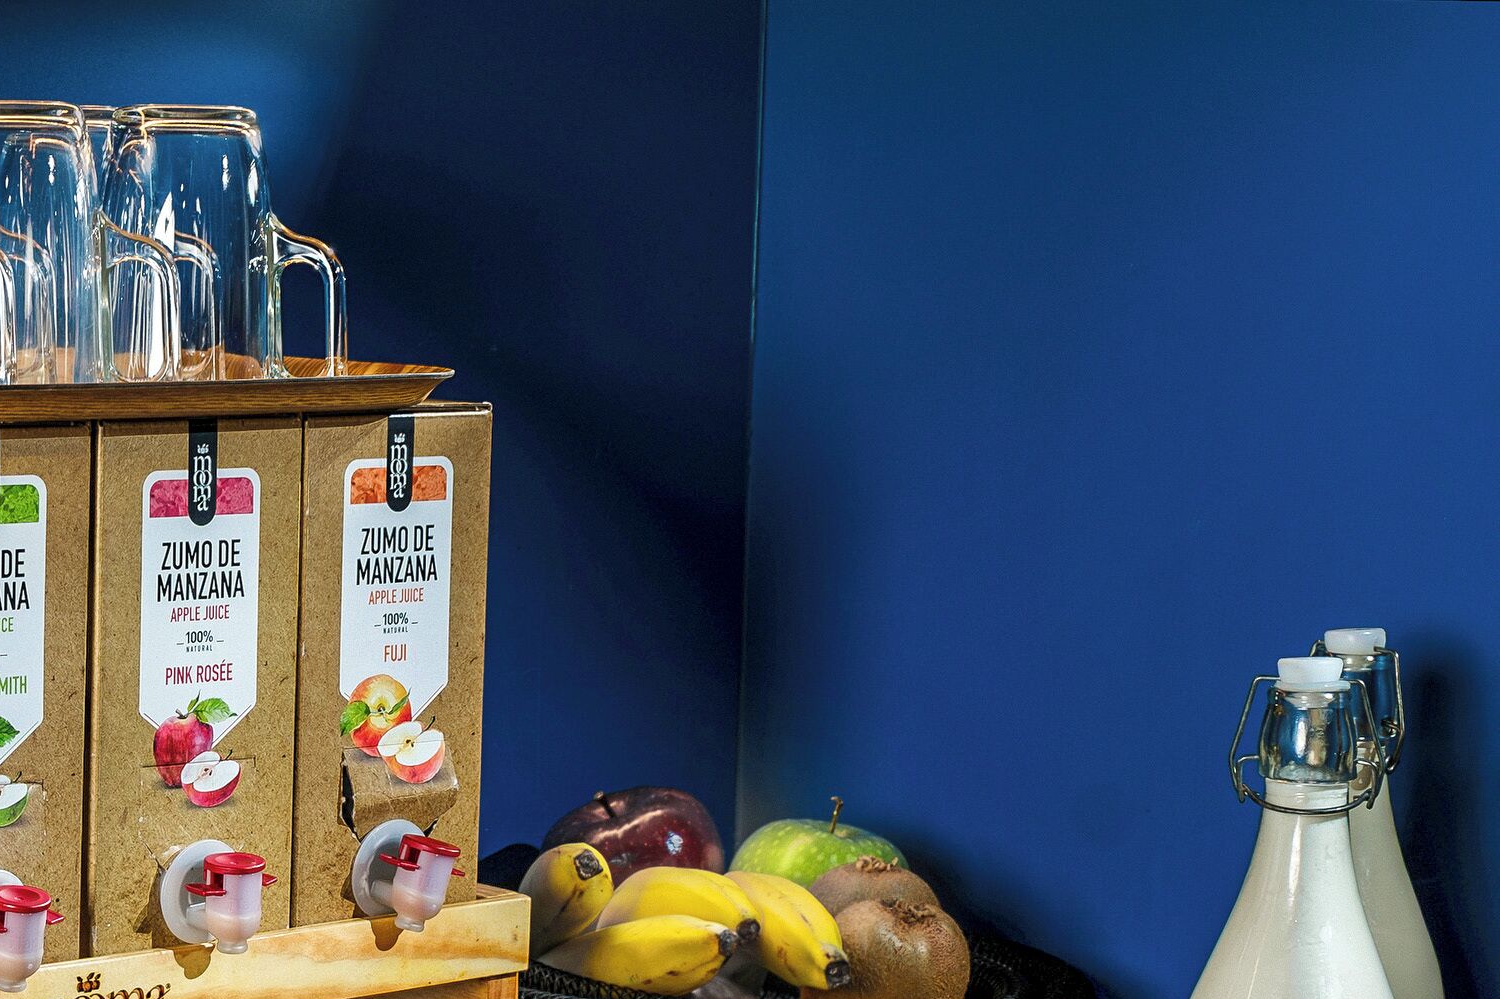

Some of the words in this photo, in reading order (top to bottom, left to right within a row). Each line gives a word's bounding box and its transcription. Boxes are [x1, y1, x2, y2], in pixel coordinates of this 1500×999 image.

[361, 526, 409, 555] ZUMO
[414, 524, 435, 551] DE
[1, 549, 26, 578] DE
[161, 540, 212, 571] ZUMO
[218, 539, 241, 567] DE
[356, 554, 438, 586] MANZANA
[157, 570, 245, 602] MANZANA
[368, 588, 397, 605] APPLE
[399, 587, 424, 603] JUICE
[170, 606, 200, 623] APPLE
[203, 604, 230, 620] JUICE
[382, 612, 409, 626] 100%
[185, 630, 214, 644] 100%
[383, 626, 409, 634] NATURAL
[186, 645, 213, 653] NATURAL
[384, 643, 407, 662] FUJI
[165, 666, 193, 685] PINK
[197, 659, 233, 683] ROSÉE
